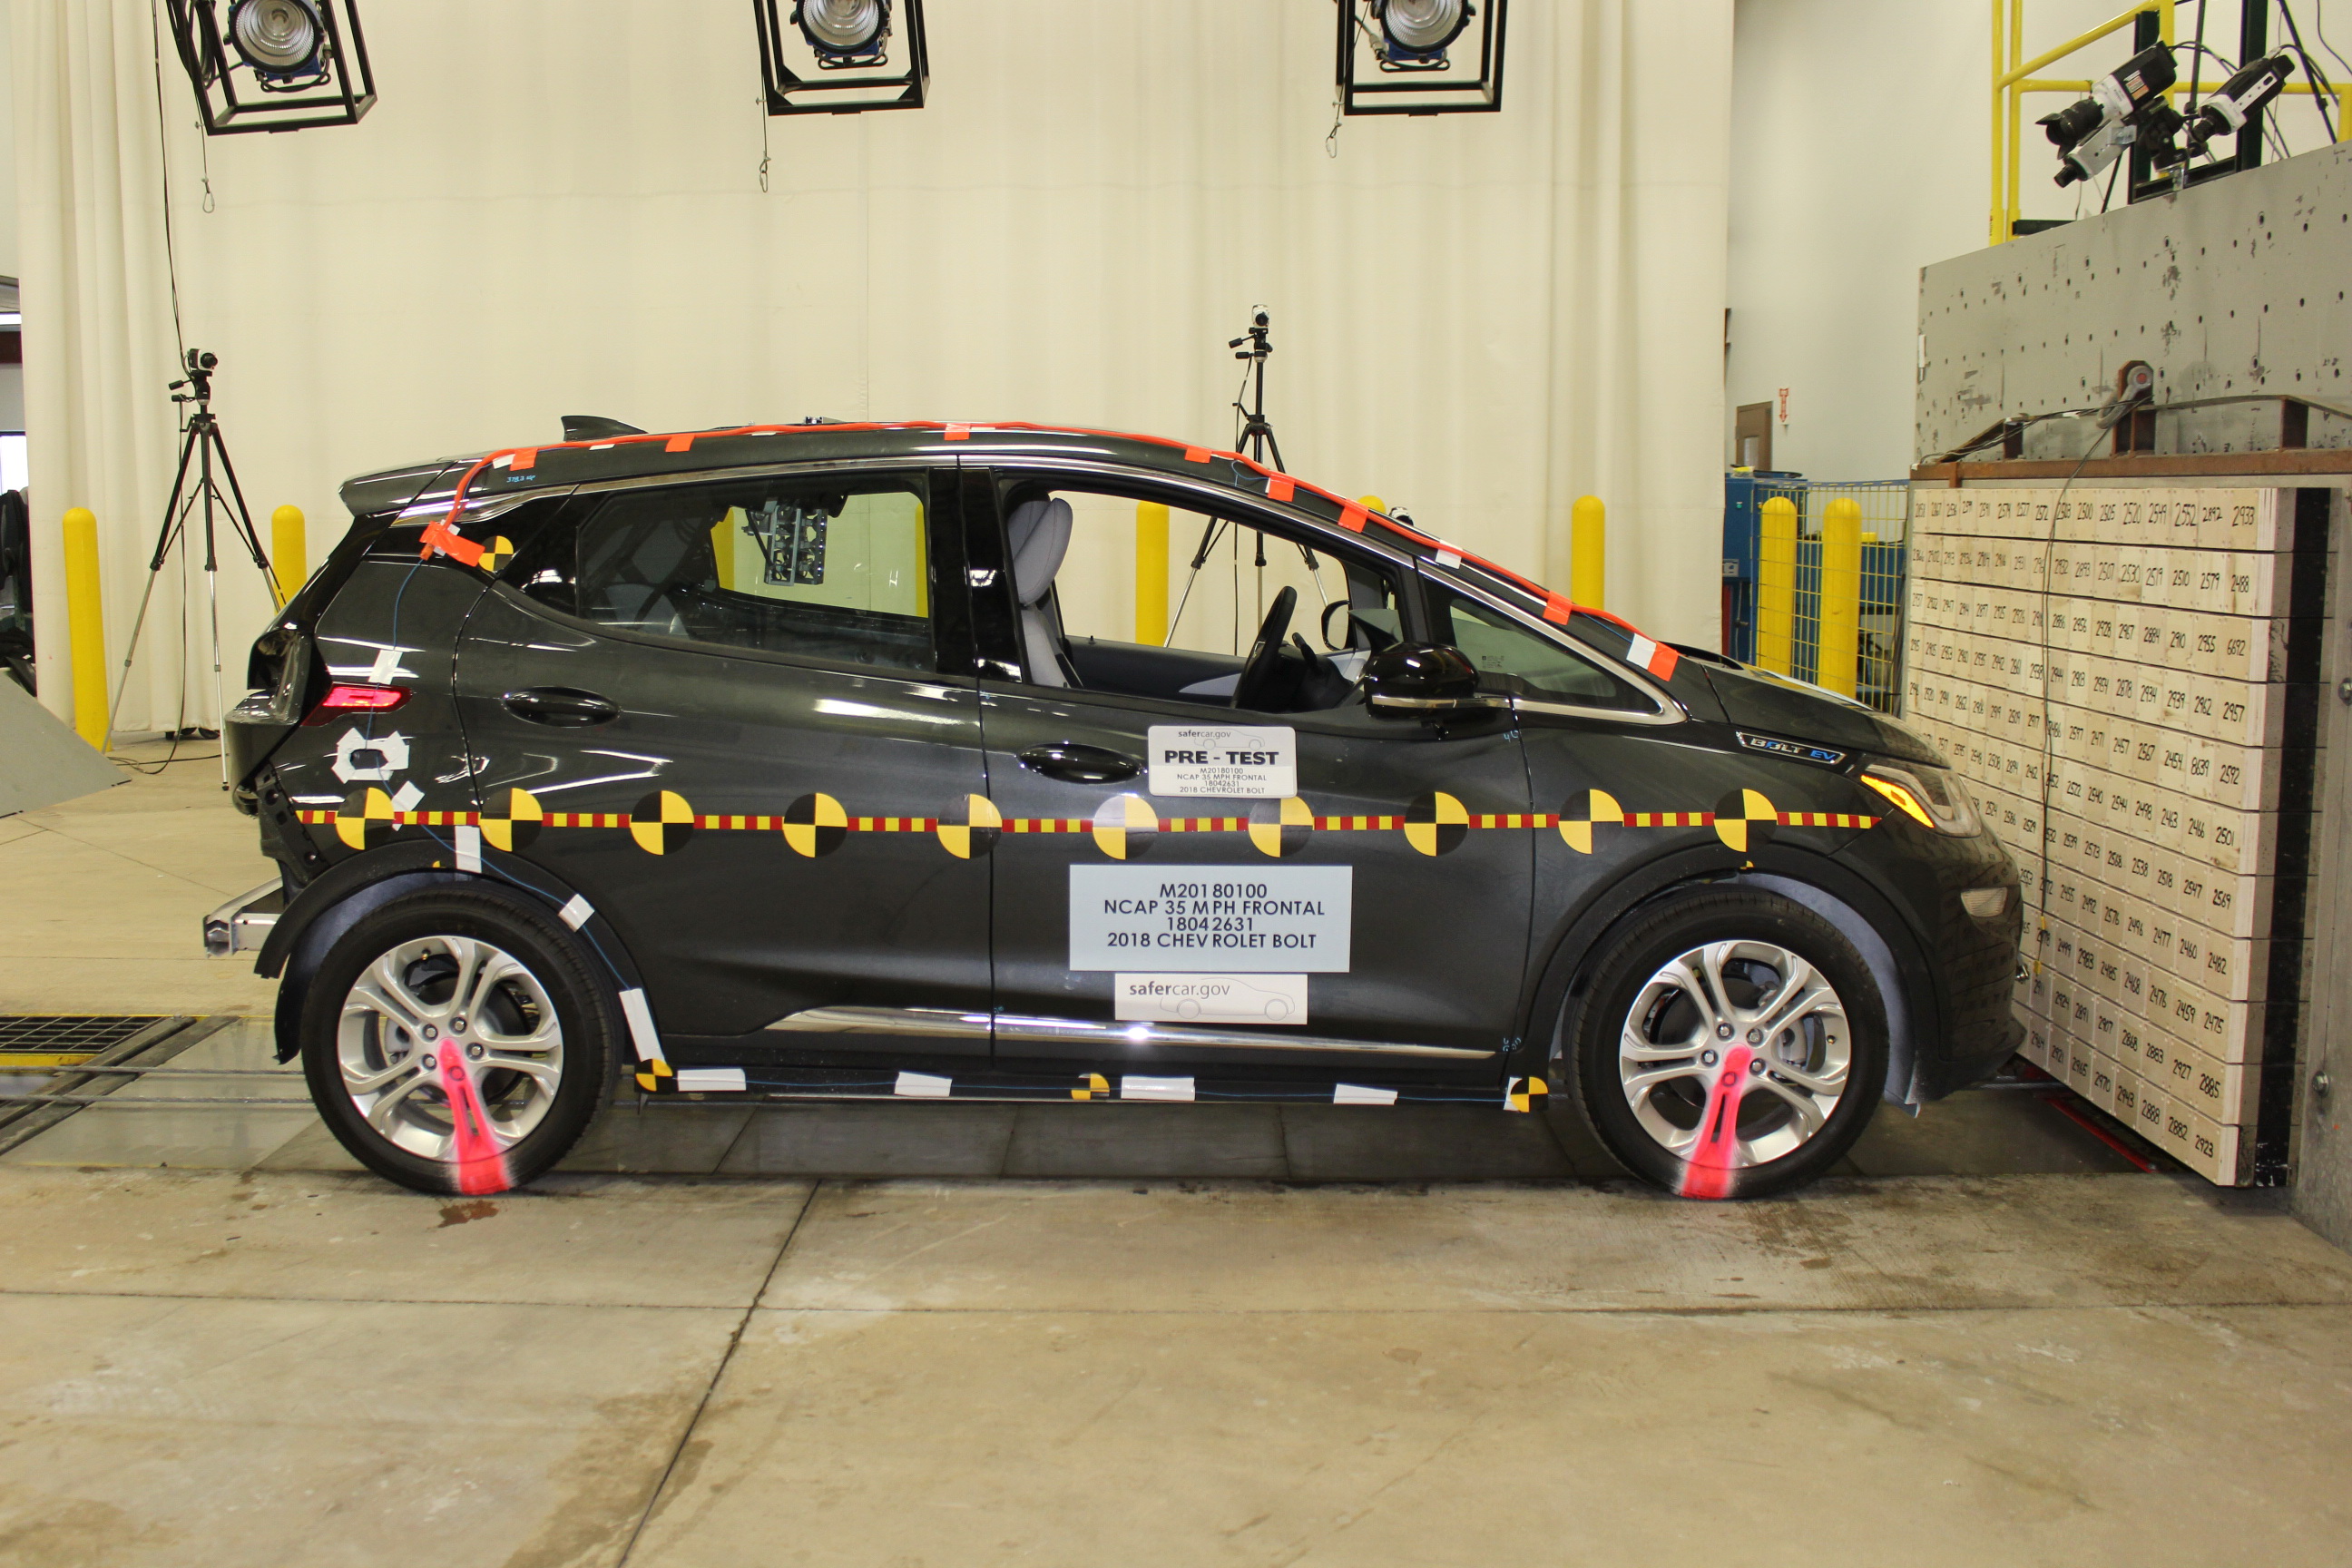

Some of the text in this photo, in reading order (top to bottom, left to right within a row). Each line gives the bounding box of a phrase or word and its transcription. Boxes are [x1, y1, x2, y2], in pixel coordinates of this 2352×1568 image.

[2077, 503, 2092, 520] 2500
[2123, 503, 2141, 524] 2520
[2149, 503, 2167, 523] 2549
[2175, 503, 2197, 526] 2552
[2203, 507, 2222, 522] 2892
[2232, 506, 2255, 526] 2933
[2098, 562, 2114, 581] 2507
[2122, 564, 2140, 583] 2530
[2146, 568, 2162, 586] 2519
[2173, 570, 2189, 586] 2510
[2200, 573, 2220, 589] 2579
[2231, 574, 2249, 593] 2488
[2096, 621, 2111, 637] 2928
[2119, 623, 2134, 640] 2967
[2144, 627, 2160, 643] 2884
[2171, 632, 2185, 648] 2910
[2198, 635, 2216, 652] 2955
[2228, 639, 2245, 656] 6692
[2116, 679, 2132, 698] 2878
[2141, 685, 2157, 703] 2934
[2168, 691, 2185, 710] 2939
[2194, 696, 2211, 715] 2962
[2223, 702, 2245, 721] 2957
[1178, 730, 1231, 739] safercar.gov
[1750, 738, 1836, 760] BOLT EV
[1165, 750, 1208, 764] PRE
[1227, 751, 1279, 765] TEST
[2070, 726, 2083, 740] 2597
[2091, 730, 2104, 745] 2471
[2114, 738, 2130, 753] 2457
[2138, 743, 2155, 760] 2567
[2164, 750, 2182, 769] 2454
[2191, 757, 2209, 775] 8639
[2220, 765, 2239, 784] 2592
[2067, 781, 2081, 797] 2522
[2088, 787, 2102, 804] 2540
[2112, 795, 2127, 811] 2544
[2135, 801, 2151, 820] 2498
[2161, 808, 2178, 828] 2463
[2189, 818, 2204, 838] 2466
[2216, 827, 2234, 845] 2501
[2084, 841, 2100, 858] 2573
[2108, 850, 2122, 867] 2568
[2132, 858, 2148, 877] 2538
[2158, 869, 2172, 887] 2518
[2184, 879, 2202, 898] 2547
[2213, 889, 2230, 909] 2569
[1160, 884, 1267, 898] M20180100
[1104, 900, 1325, 916] NCAP 35 MPH FRONTAL
[1167, 917, 1253, 931] 18042631
[2061, 885, 2074, 902] 2455
[2082, 895, 2096, 914] 2492
[2104, 906, 2119, 925] 2576
[2128, 916, 2142, 936] 2496
[2153, 927, 2171, 947] 2477
[2180, 939, 2197, 959] 2460
[2208, 953, 2226, 975] 2482
[1108, 934, 1317, 948] 2018 CHEVROLET BOLT
[1130, 981, 1230, 999] safercar.gov
[2058, 938, 2071, 956] 2499
[2101, 961, 2117, 981] 2485
[2124, 972, 2140, 995] 2468
[2150, 985, 2166, 1008] 2476
[2176, 1000, 2195, 1023] 2459
[2204, 1012, 2224, 1034] 2475
[2075, 1003, 2088, 1022] 2891
[2098, 1016, 2113, 1032] 2907
[2122, 1029, 2137, 1051] 2868
[2146, 1043, 2163, 1063] 2883
[2173, 1059, 2191, 1079] 2927
[2200, 1073, 2220, 1098] 2885
[2072, 1057, 2088, 1076] 2965
[2094, 1072, 2111, 1092] 2970
[2117, 1085, 2134, 1108] 2943
[2141, 1100, 2160, 1124] 2888
[2169, 1116, 2187, 1140] 2882
[2195, 1135, 2213, 1158] 2923
